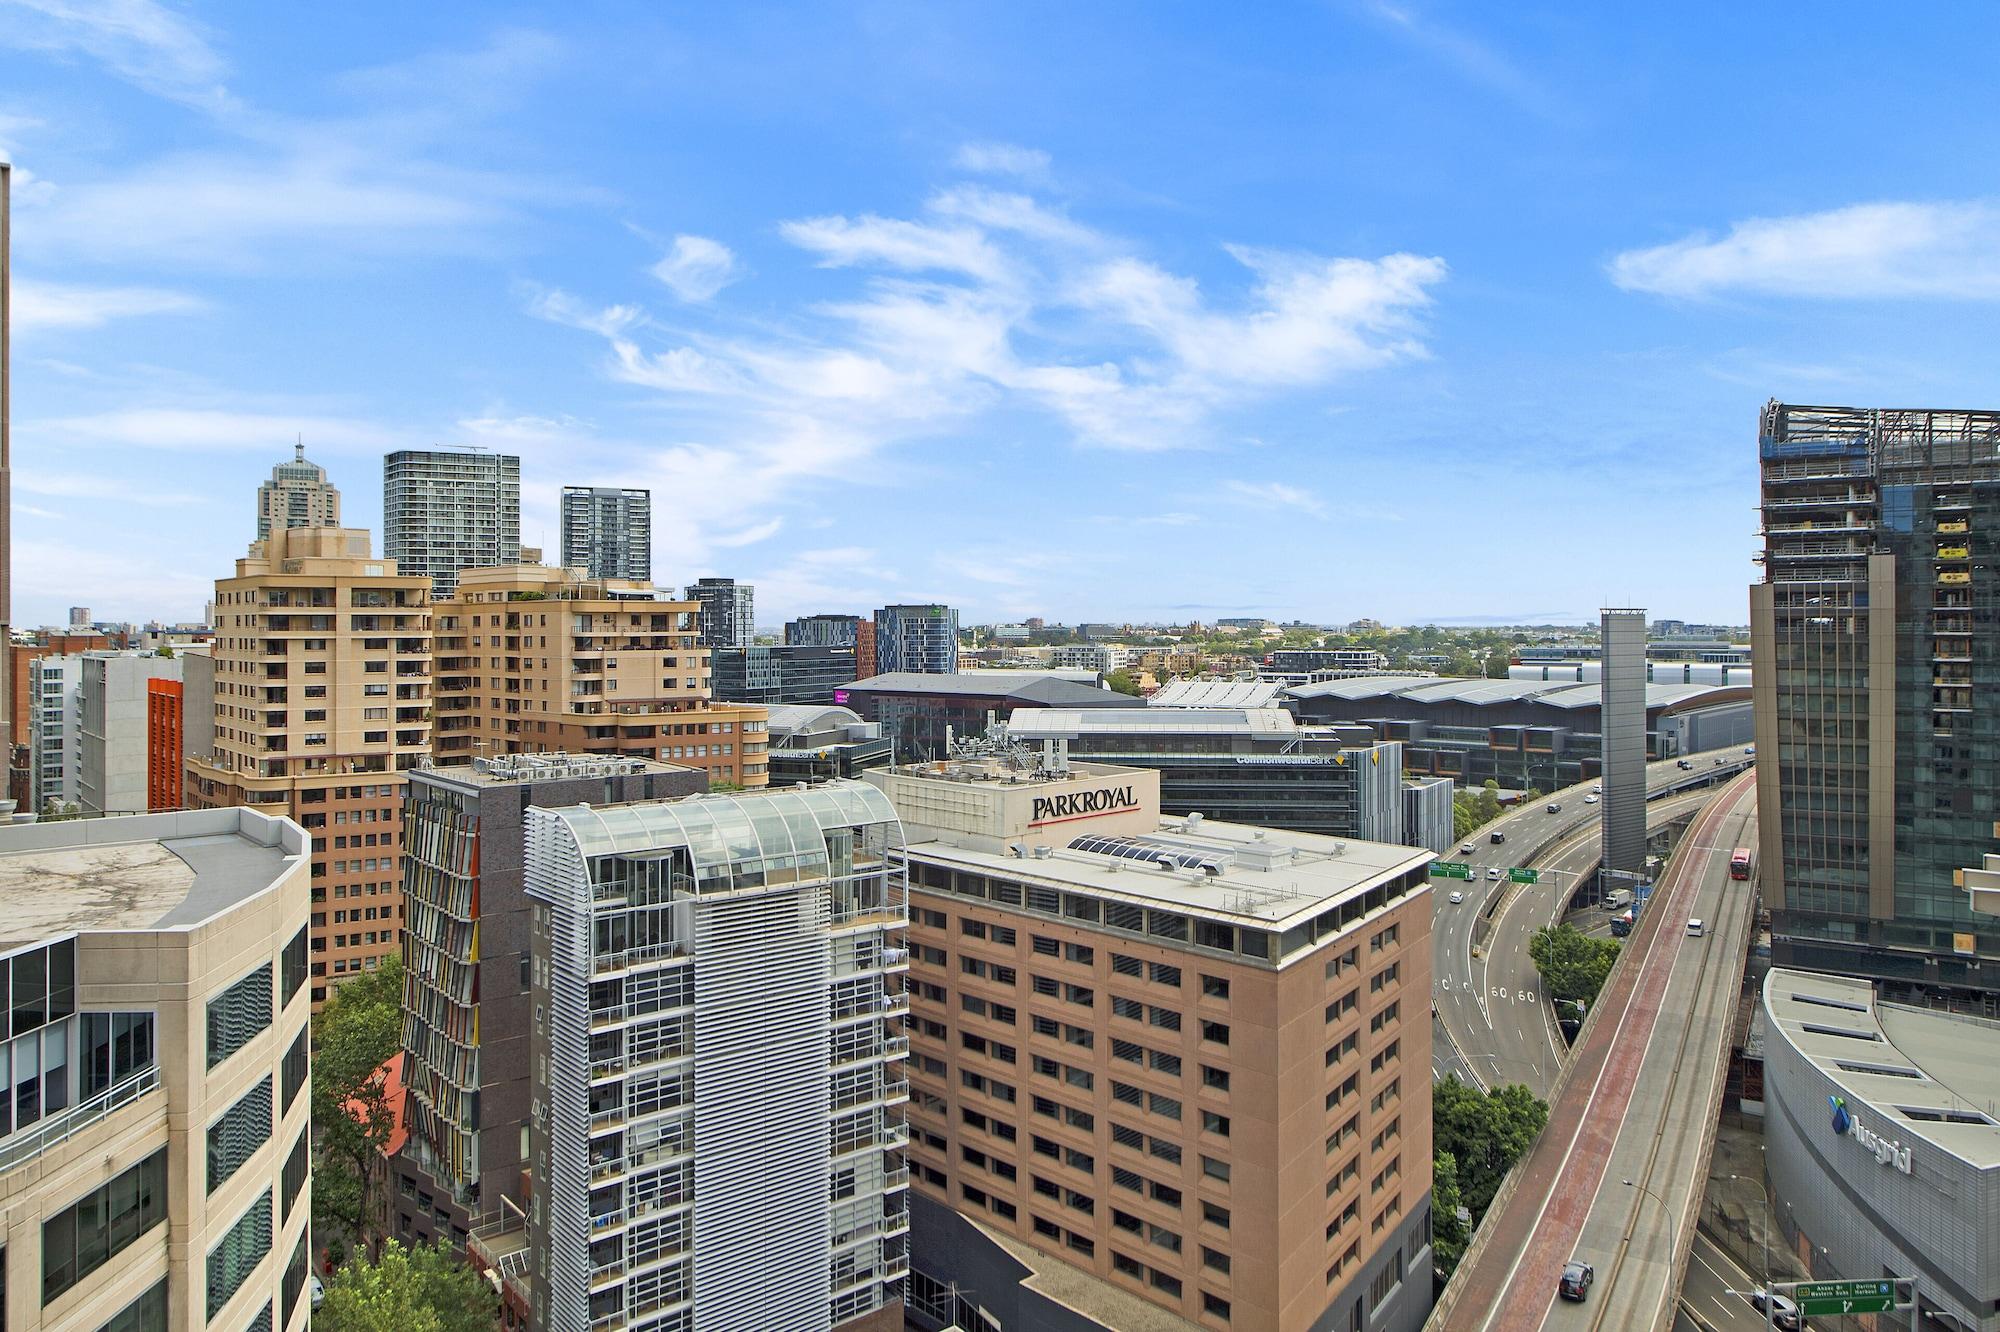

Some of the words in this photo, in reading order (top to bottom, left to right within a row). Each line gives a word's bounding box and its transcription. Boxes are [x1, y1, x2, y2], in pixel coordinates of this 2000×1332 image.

[1236, 754, 1331, 765] CommonwealthBank
[1032, 785, 1138, 817] PARKROYAL
[1492, 986, 1508, 999] 60
[1518, 990, 1535, 1003] 60
[1848, 1114, 1912, 1174] Ausgrid
